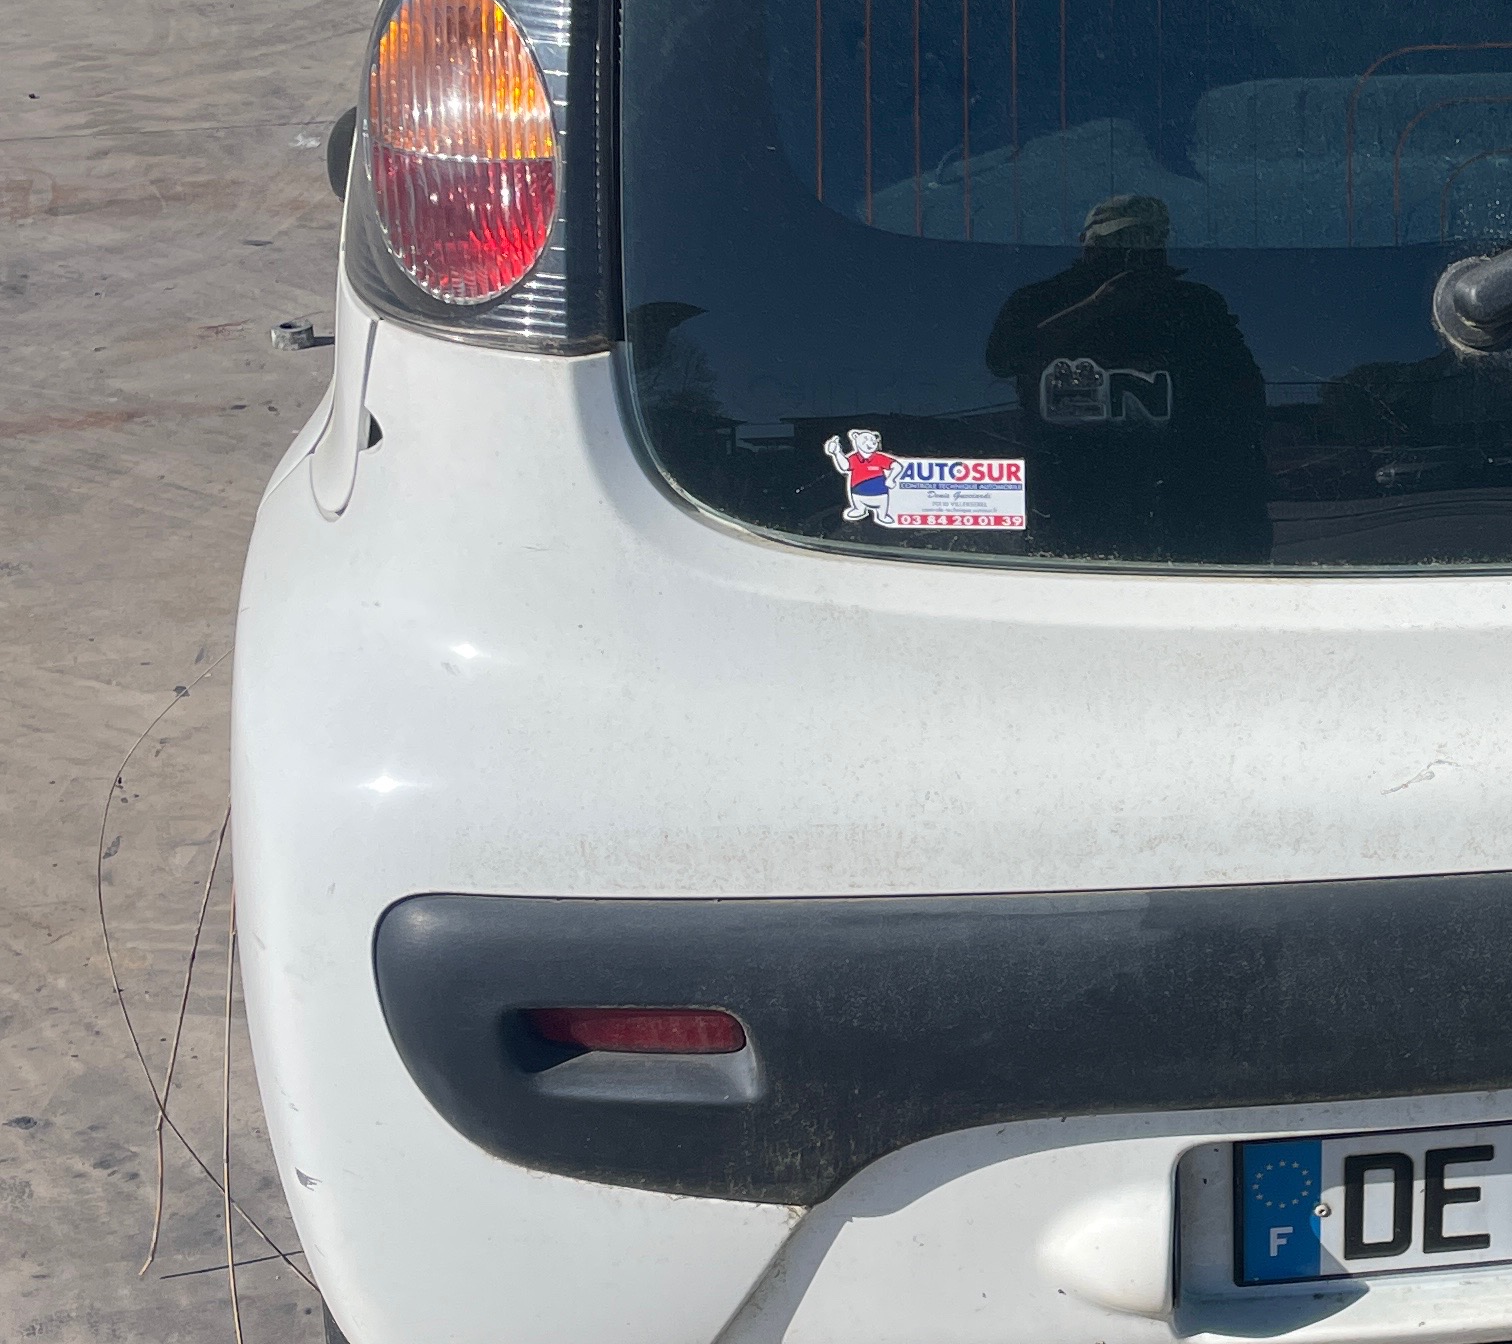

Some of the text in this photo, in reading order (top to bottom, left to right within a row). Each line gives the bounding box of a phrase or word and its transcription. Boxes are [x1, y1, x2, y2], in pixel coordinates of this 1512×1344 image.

[899, 461, 1022, 482] AUTOSUR
[901, 516, 1023, 526] 03 84 20 01 39
[1269, 1226, 1293, 1257] F
